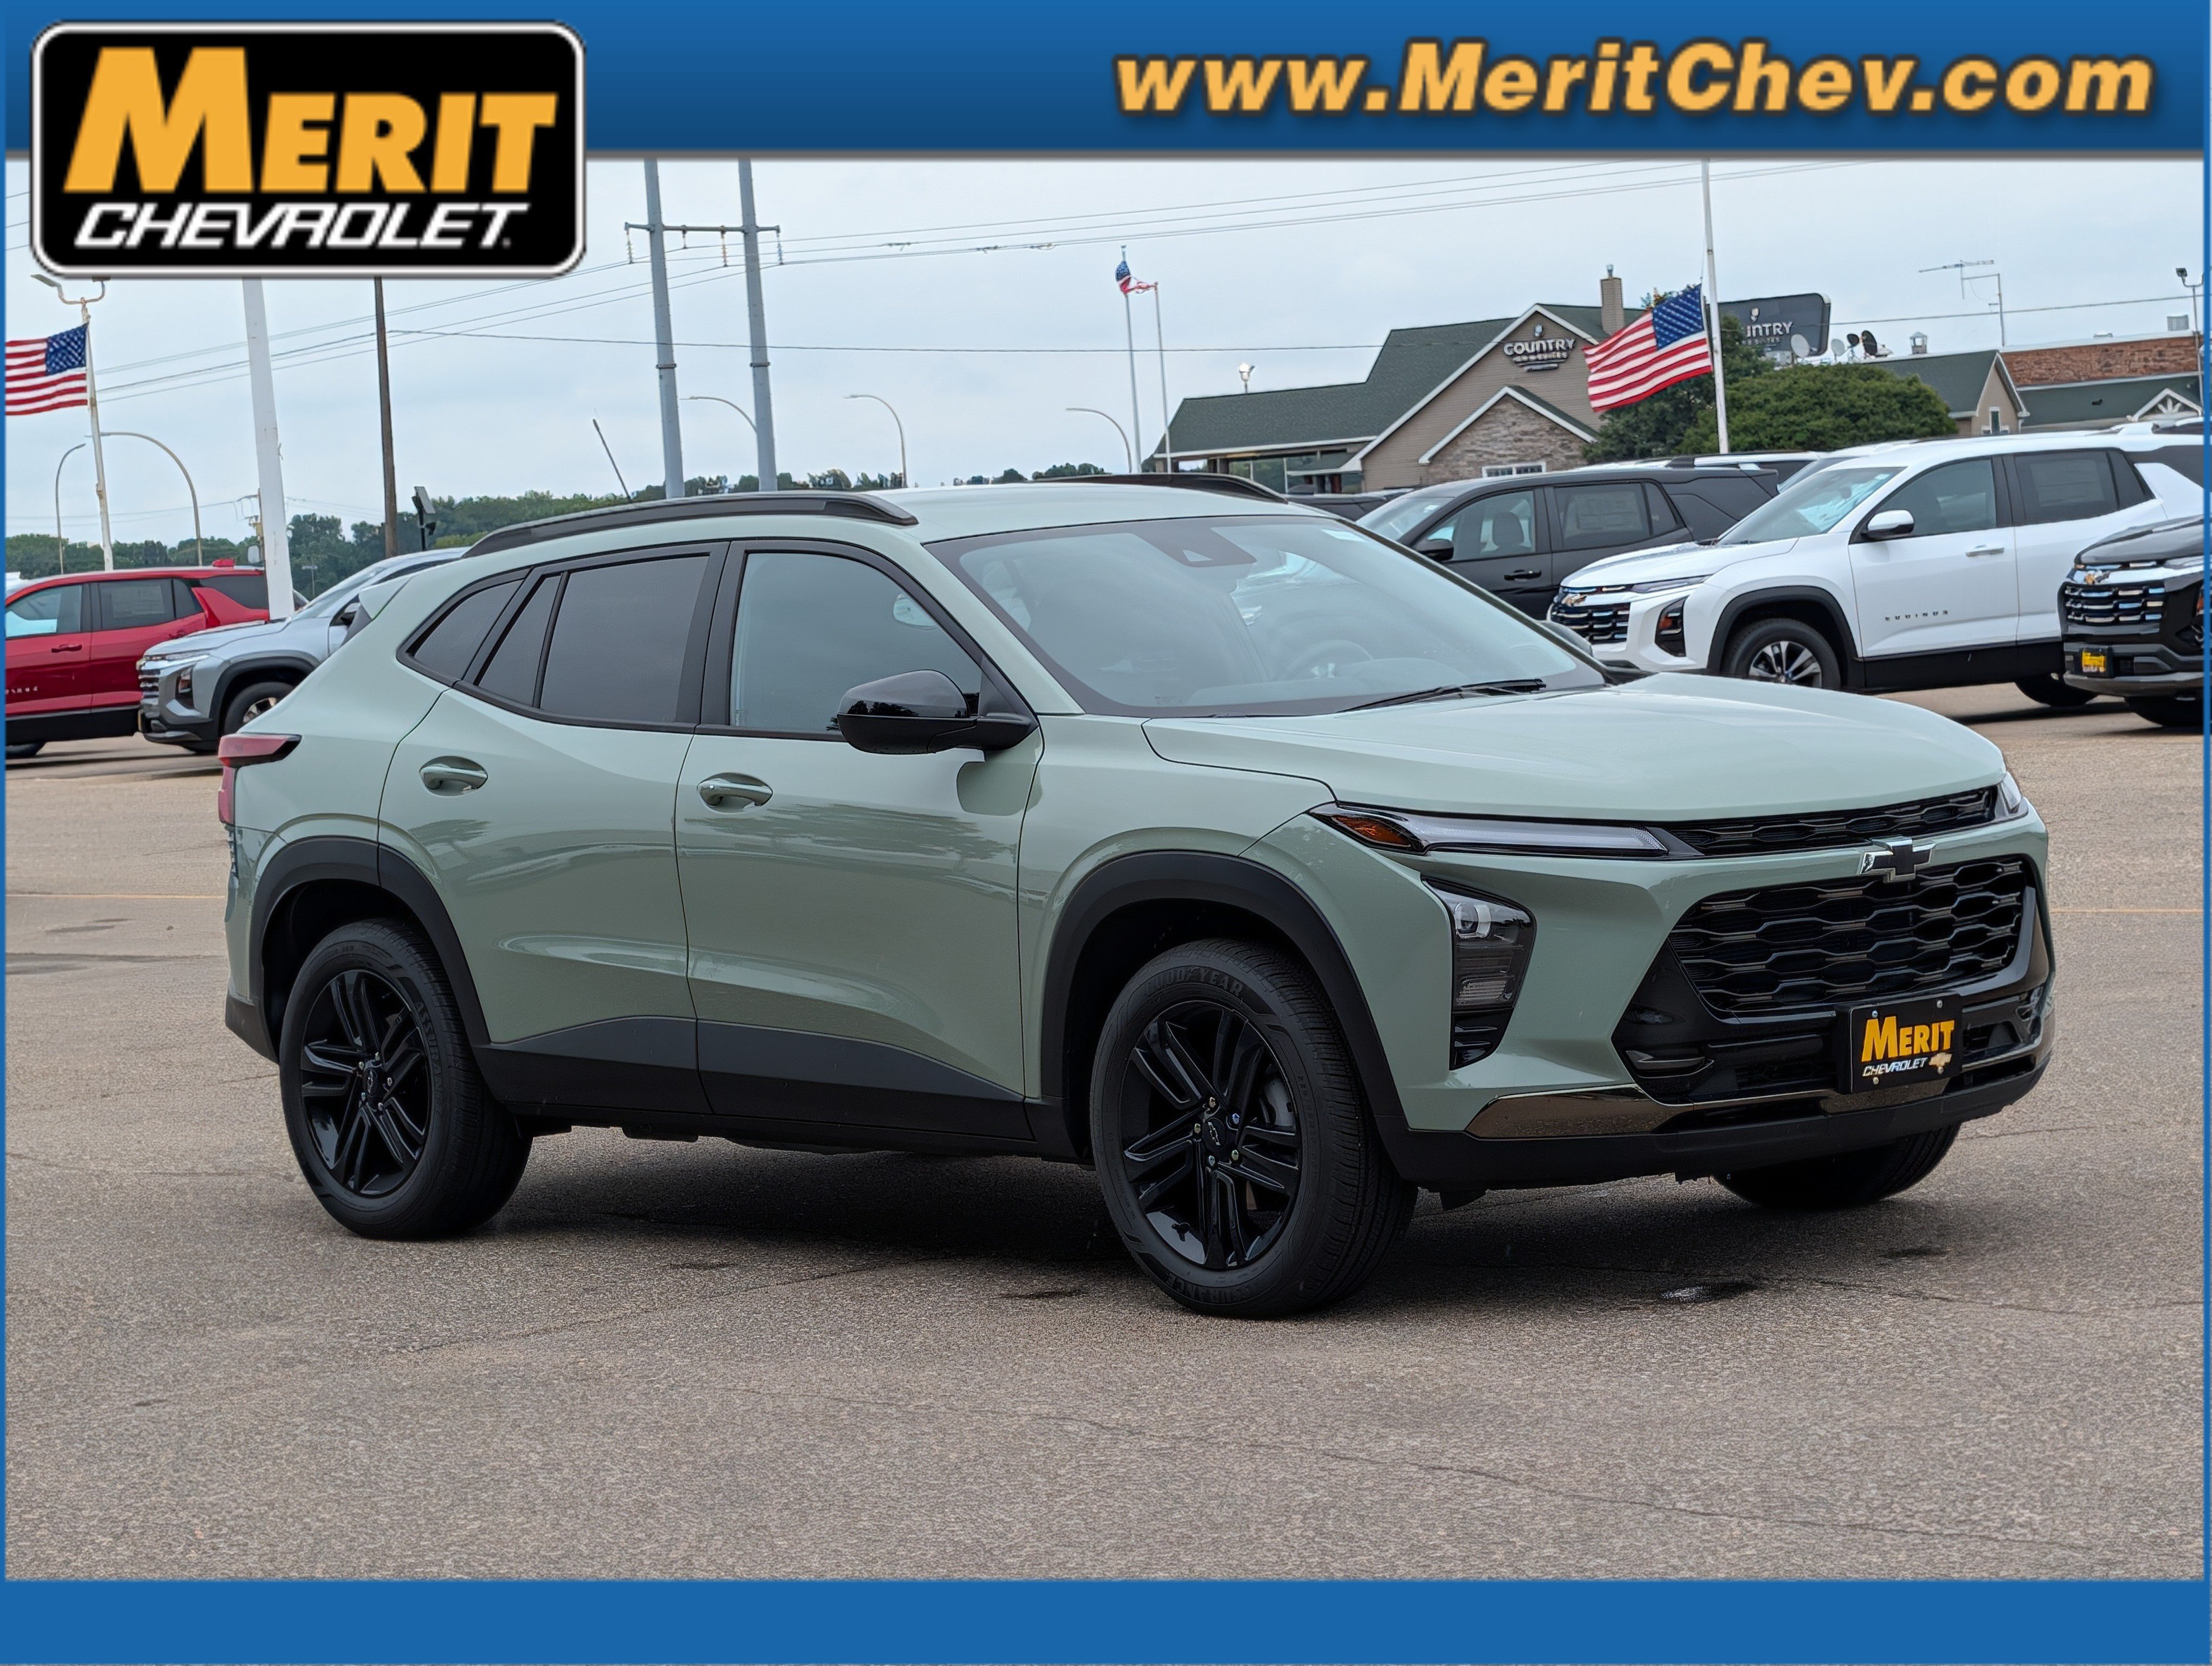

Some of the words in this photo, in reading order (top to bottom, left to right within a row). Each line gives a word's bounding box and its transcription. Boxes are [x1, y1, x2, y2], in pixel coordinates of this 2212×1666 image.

[1503, 338, 1575, 355] COUNTRY
[1861, 1016, 1955, 1062] MERIT
[1862, 1057, 1928, 1077] CHEVROLET
